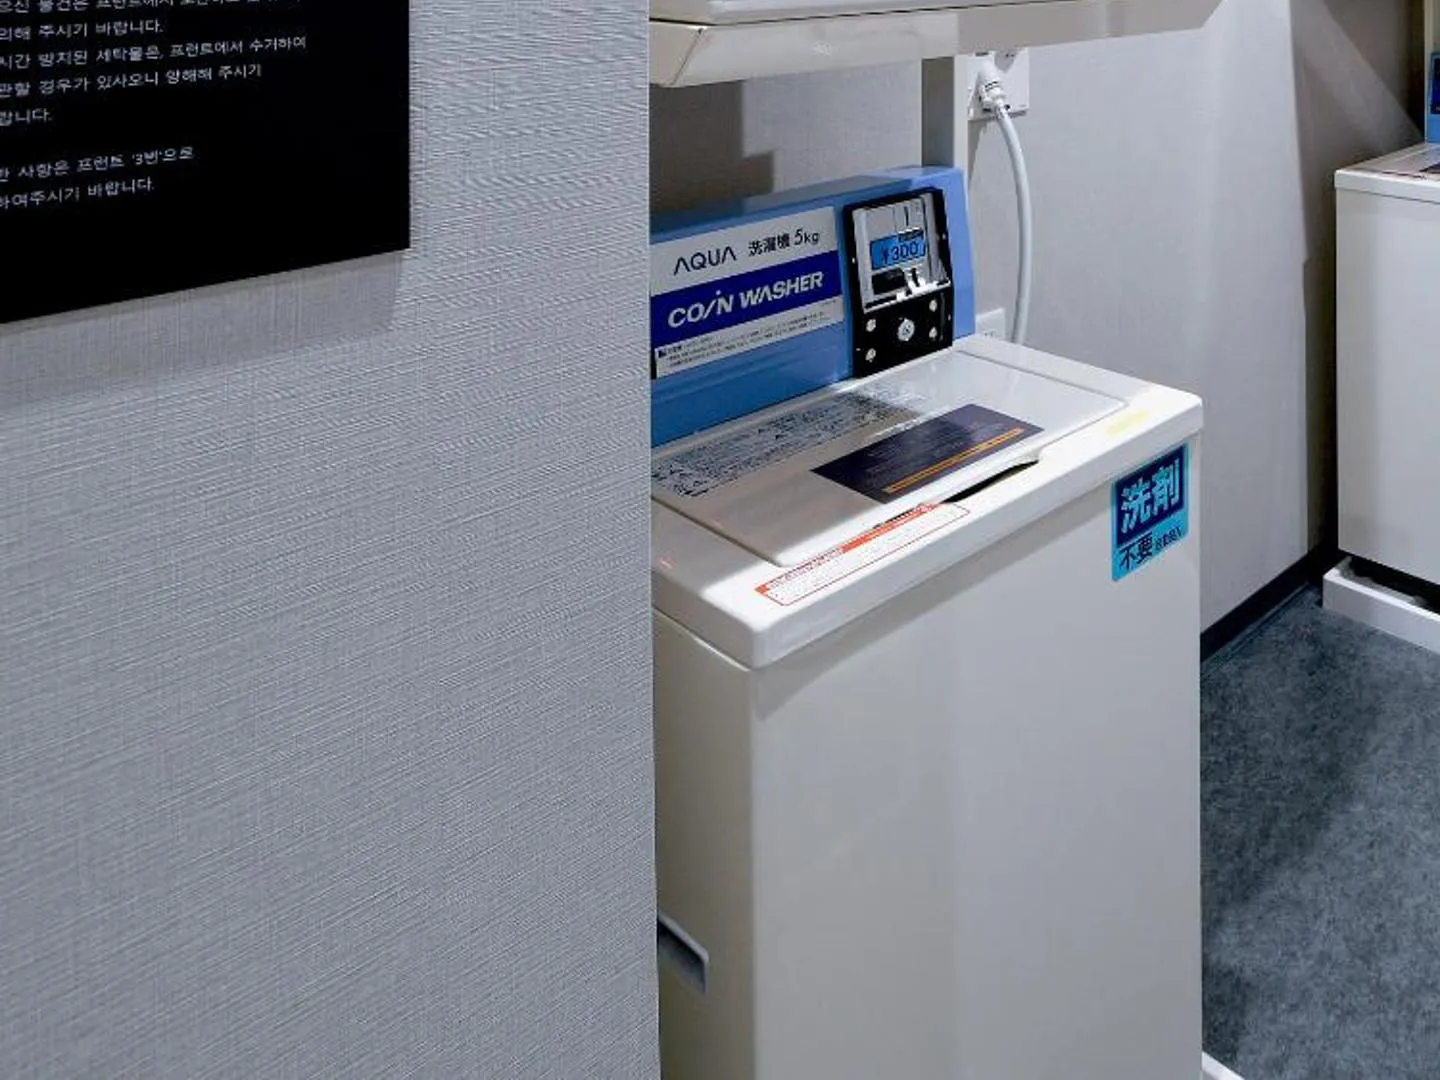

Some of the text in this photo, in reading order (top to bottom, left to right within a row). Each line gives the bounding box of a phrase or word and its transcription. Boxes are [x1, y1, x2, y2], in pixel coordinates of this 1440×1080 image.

[39, 23, 88, 38] 주시기
[169, 40, 244, 58] 프런트에서
[219, 63, 262, 80] 주시기
[77, 154, 125, 172] 프런트
[673, 246, 737, 276] AQUA
[794, 228, 820, 250] 5kg
[667, 270, 824, 328] COIN WASHER
[1121, 458, 1181, 534] 洗剤
[1118, 531, 1153, 571] 不要
